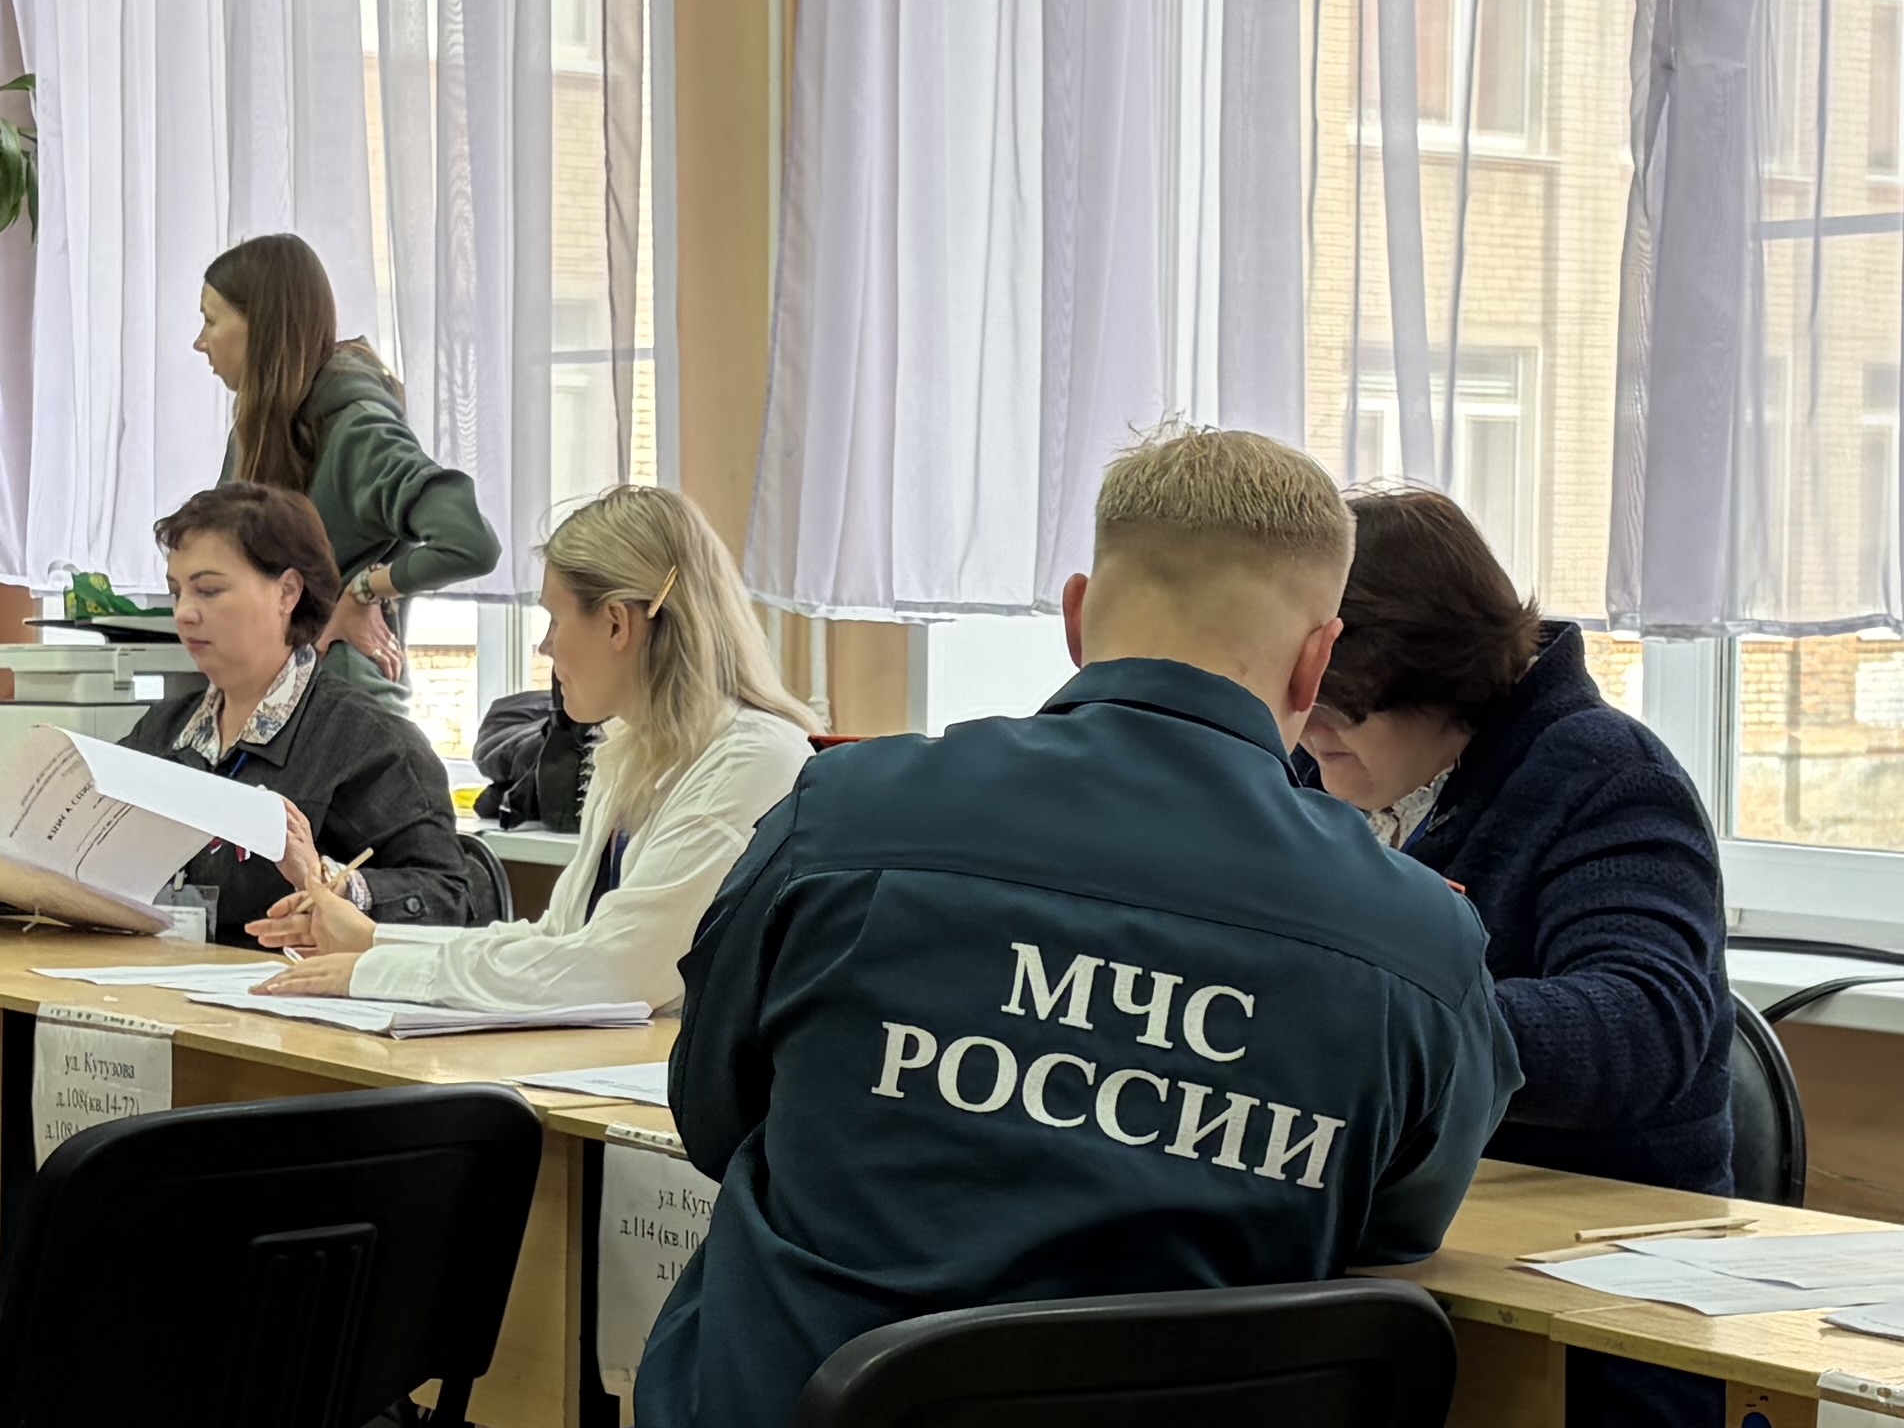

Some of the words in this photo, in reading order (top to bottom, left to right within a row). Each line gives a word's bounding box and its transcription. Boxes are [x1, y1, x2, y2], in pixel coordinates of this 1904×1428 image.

[1000, 941, 1255, 1062] МЧС
[84, 1051, 136, 1081] Кутузова
[870, 1020, 1347, 1190] РОССИИ
[657, 1188, 678, 1211] ул.
